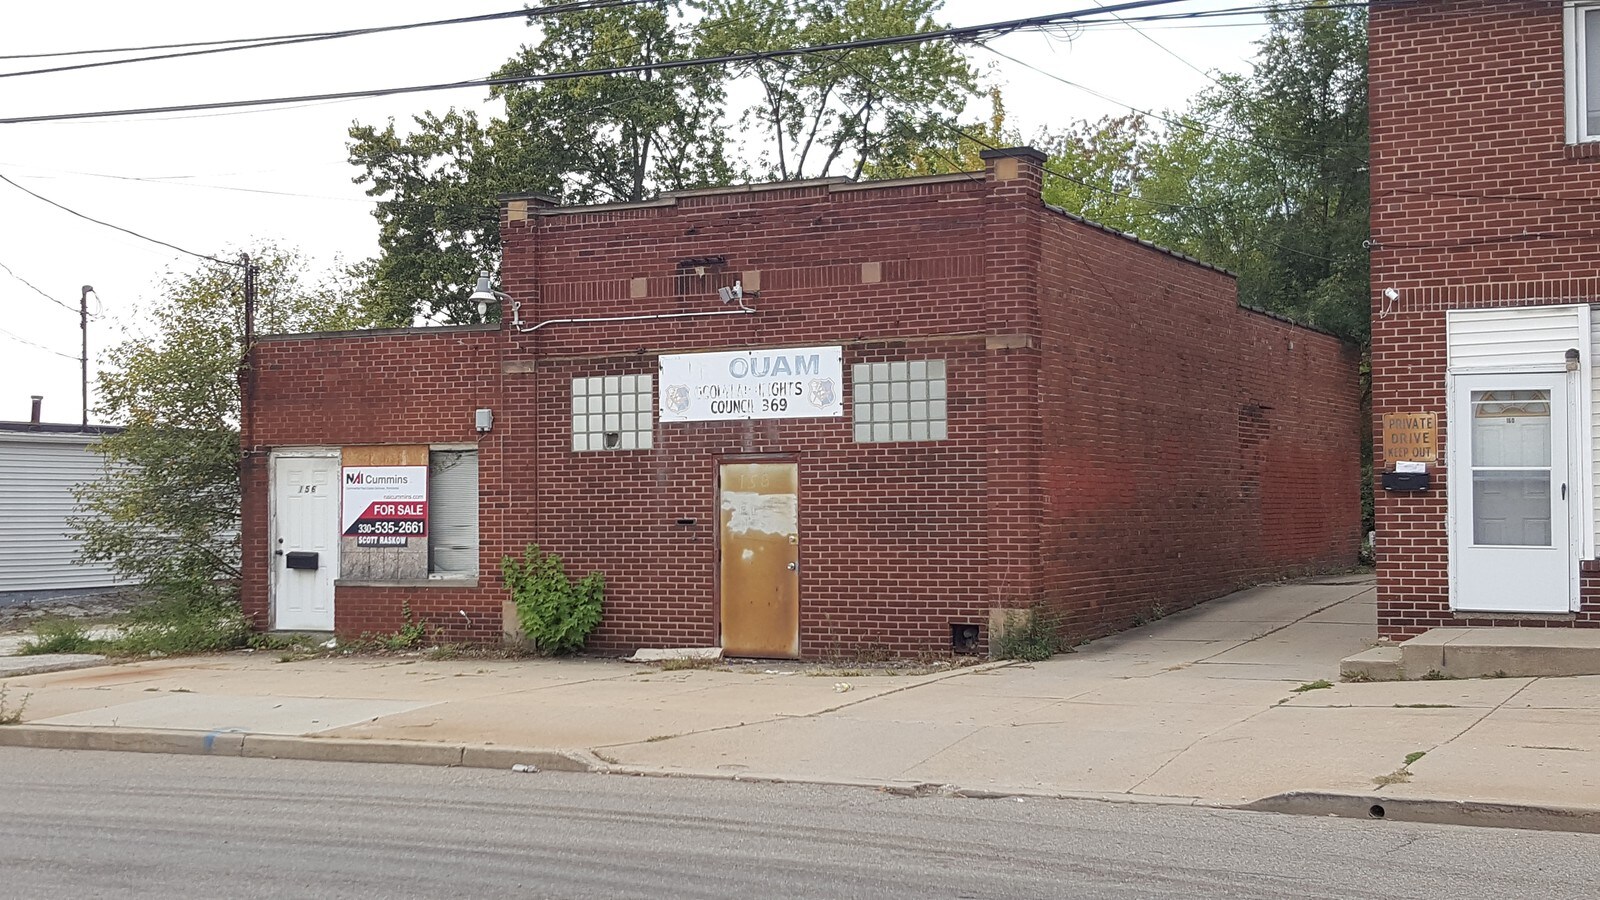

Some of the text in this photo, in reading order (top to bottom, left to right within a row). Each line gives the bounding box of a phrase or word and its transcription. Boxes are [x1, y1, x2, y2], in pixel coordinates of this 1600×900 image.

[729, 354, 820, 378] OUAM
[762, 398, 788, 412] 369
[1389, 417, 1432, 429] PRIVATE
[1391, 432, 1430, 444] DRIVE
[1388, 446, 1431, 457] KEEP OUT
[346, 470, 408, 484] NAI Cummins
[297, 485, 316, 493] 156
[374, 504, 424, 515] FOR SALE
[358, 521, 424, 534] 330-535-2661
[358, 536, 406, 544] SCOTT RASKOW
